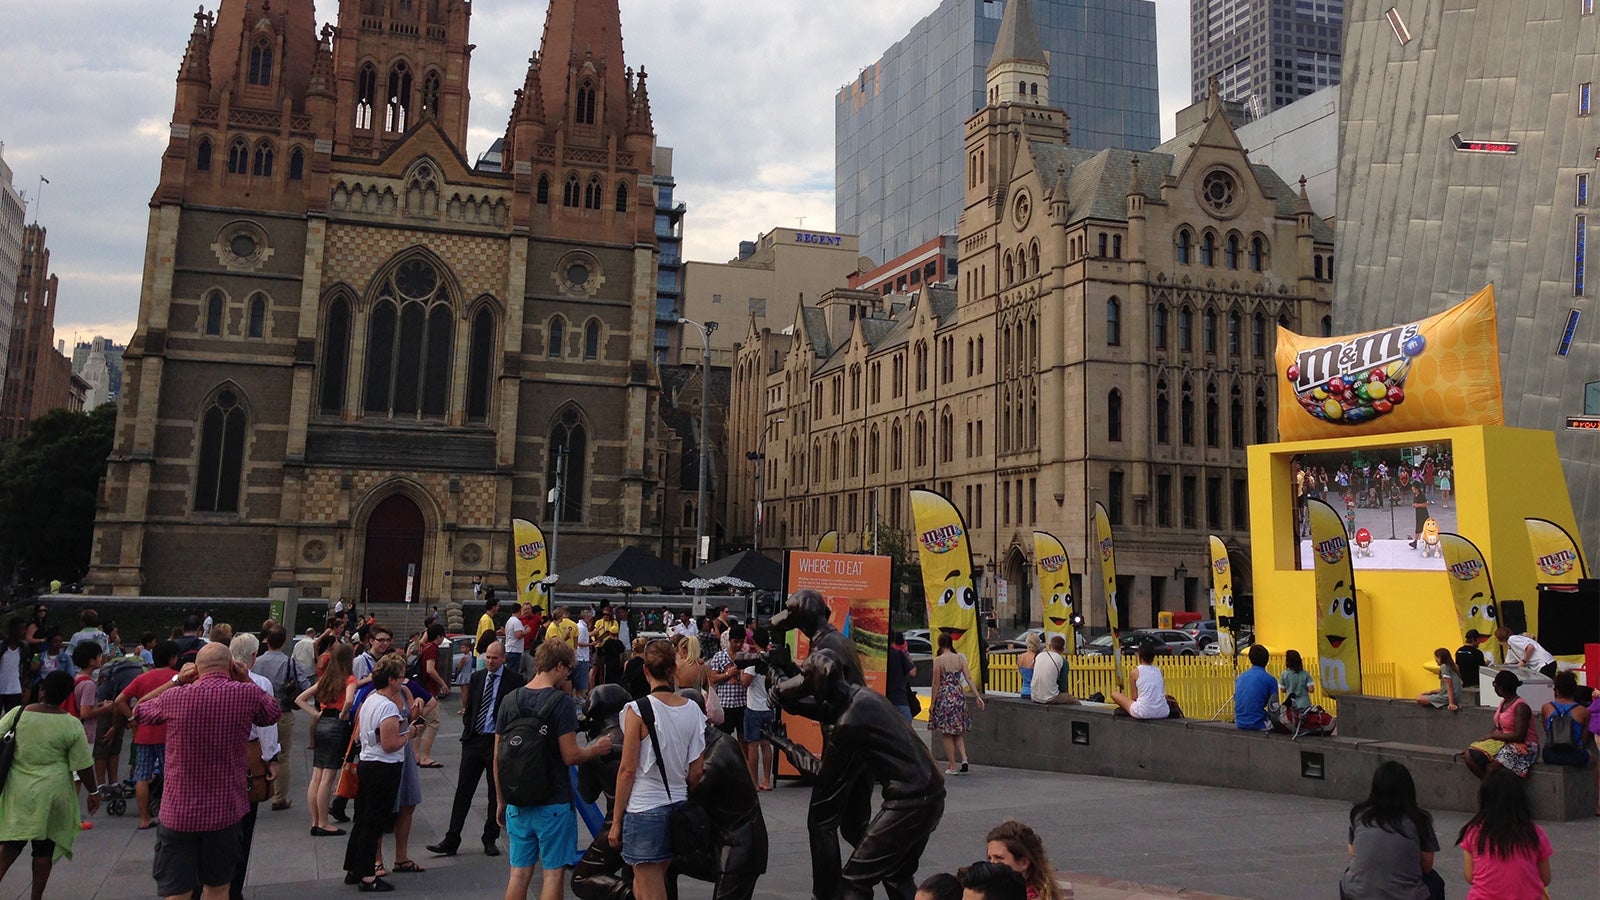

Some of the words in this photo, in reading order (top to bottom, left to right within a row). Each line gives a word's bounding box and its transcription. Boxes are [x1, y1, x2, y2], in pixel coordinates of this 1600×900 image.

[795, 232, 842, 246] REGENT
[799, 558, 831, 574] WHERE
[834, 560, 845, 575] TO
[846, 561, 864, 576] EAT
